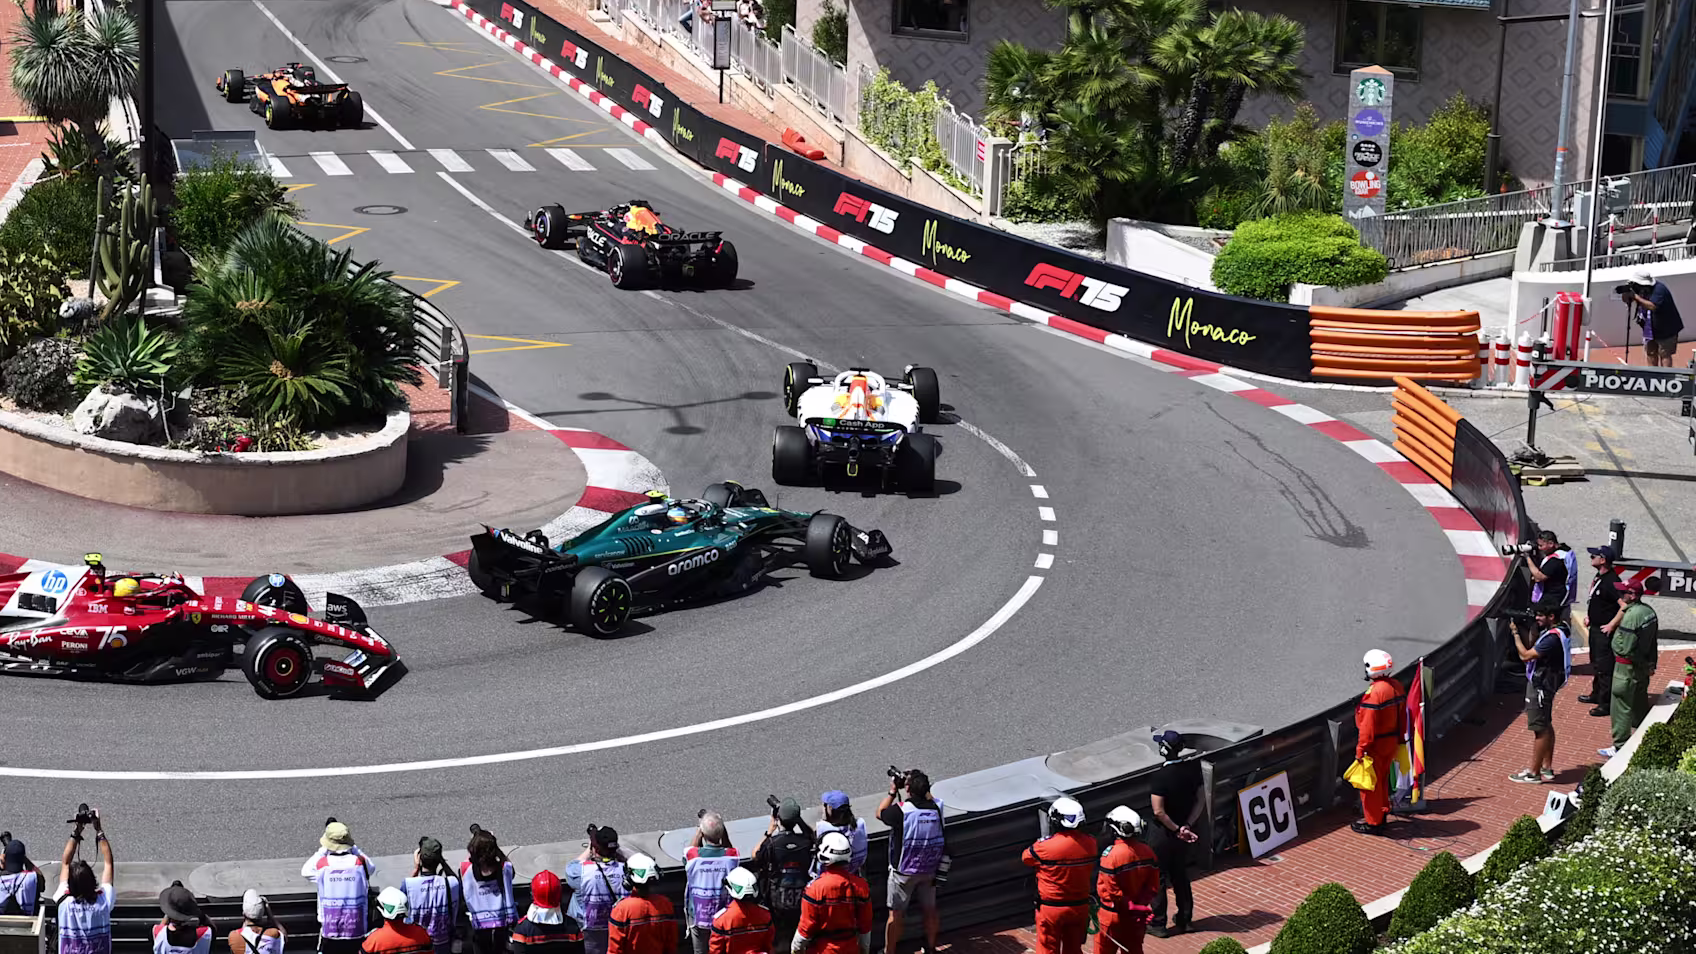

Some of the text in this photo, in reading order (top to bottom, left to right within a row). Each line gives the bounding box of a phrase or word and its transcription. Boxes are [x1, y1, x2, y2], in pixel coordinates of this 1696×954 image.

[771, 159, 806, 201] Monaco
[1349, 179, 1381, 191] BOWLING
[657, 231, 716, 243] ORACLE
[921, 218, 972, 267] Monaco
[1166, 296, 1257, 349] Monaco
[1584, 373, 1683, 393] PIOVANO
[839, 419, 885, 430] Cash App
[499, 532, 544, 555] Valvoline
[667, 548, 720, 576] aramco
[43, 570, 67, 593] hp
[87, 603, 108, 614] IBM
[326, 603, 348, 613] aws
[61, 640, 88, 649] PERONI
[1248, 786, 1291, 843] SC
